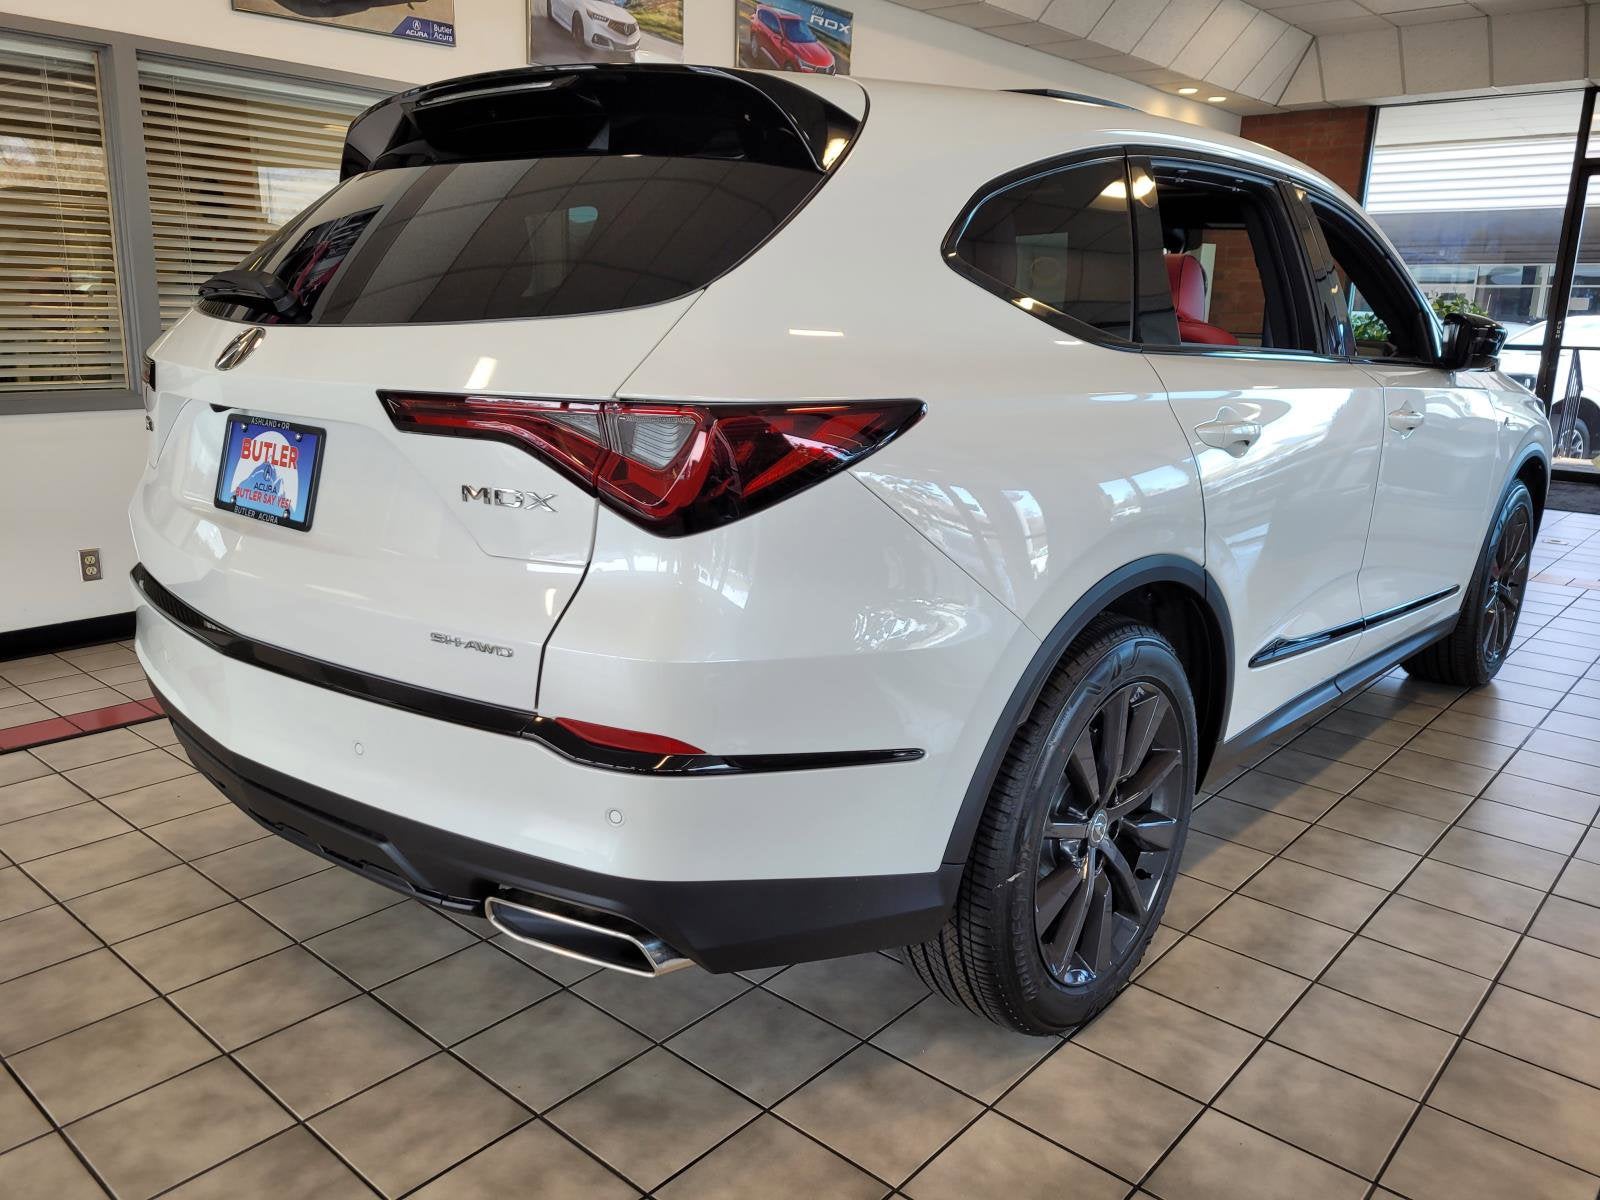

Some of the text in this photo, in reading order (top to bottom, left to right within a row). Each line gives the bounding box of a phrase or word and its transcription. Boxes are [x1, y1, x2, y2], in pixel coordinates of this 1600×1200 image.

[434, 24, 452, 34] Butler
[810, 15, 851, 34] RDX
[406, 30, 428, 38] ACURA
[434, 32, 452, 41] Acura
[251, 418, 277, 428] ASHLAND
[241, 438, 298, 469] BUTLER
[236, 487, 262, 502] BUTLER
[264, 494, 277, 505] SAY
[254, 482, 278, 495] ACURA
[461, 484, 559, 513] MDX
[235, 506, 278, 524] BUTLER ACURA
